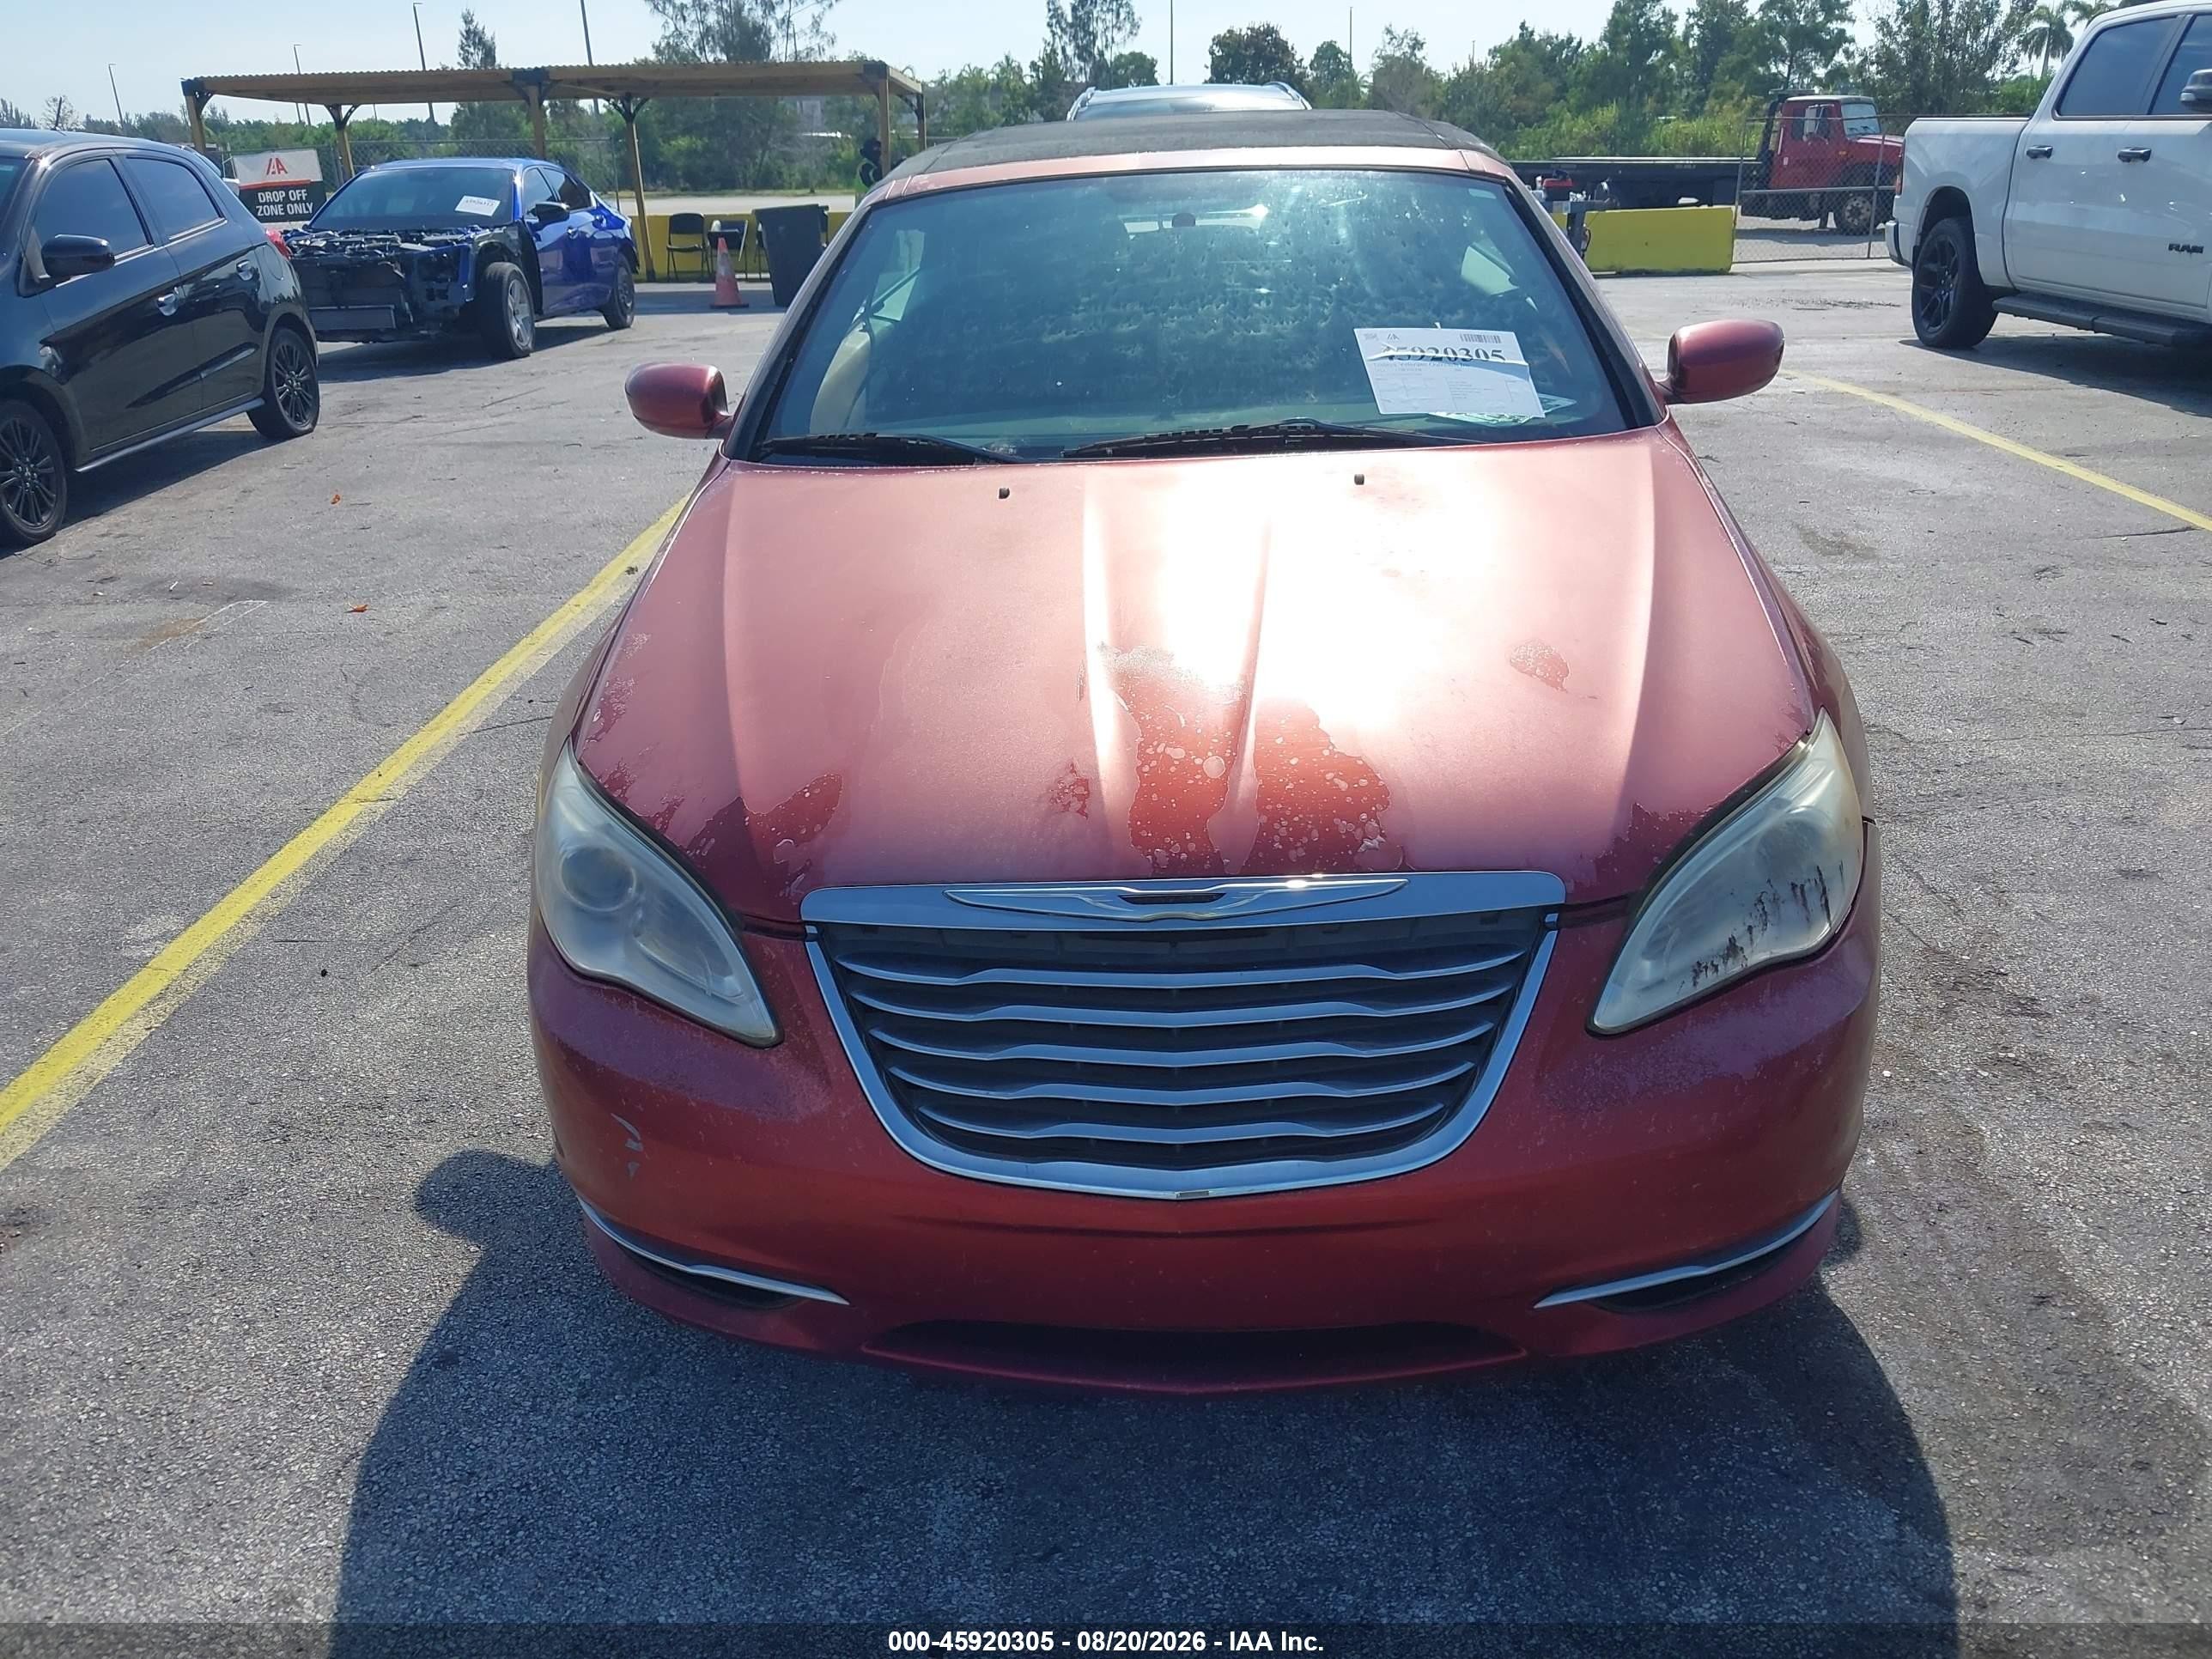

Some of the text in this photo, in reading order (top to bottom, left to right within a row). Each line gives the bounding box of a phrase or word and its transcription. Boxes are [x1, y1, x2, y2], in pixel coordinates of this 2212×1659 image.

[258, 189, 307, 203] DROP OFF
[256, 202, 313, 216] ZONE ONLY
[2168, 243, 2204, 253] RAM
